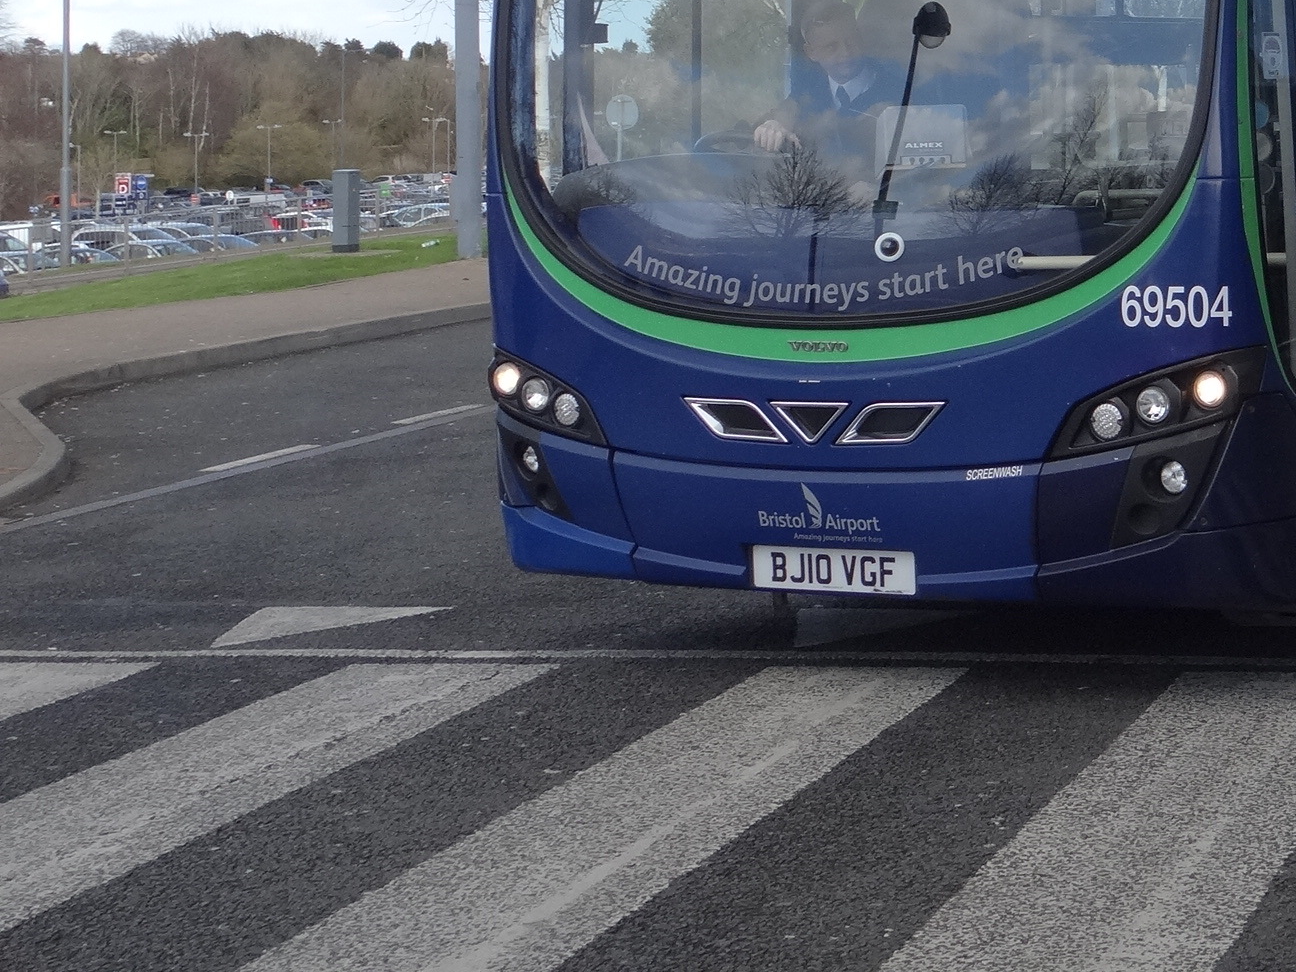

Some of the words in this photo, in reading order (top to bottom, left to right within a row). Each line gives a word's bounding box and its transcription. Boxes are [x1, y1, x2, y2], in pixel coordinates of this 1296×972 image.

[905, 141, 944, 149] ALMEX
[624, 245, 741, 305] Amazing
[743, 273, 870, 311] journeys
[878, 264, 949, 300] start
[957, 246, 1024, 285] here
[1121, 285, 1232, 328] 69504
[788, 340, 849, 353] VOLVO
[965, 465, 1023, 481] SCREENWASH
[758, 510, 806, 529] Bristol
[825, 514, 881, 535] Airport
[793, 532, 822, 543] Amazing
[822, 534, 850, 543] journeys
[770, 551, 832, 585] BJ10
[841, 554, 896, 587] VGF
